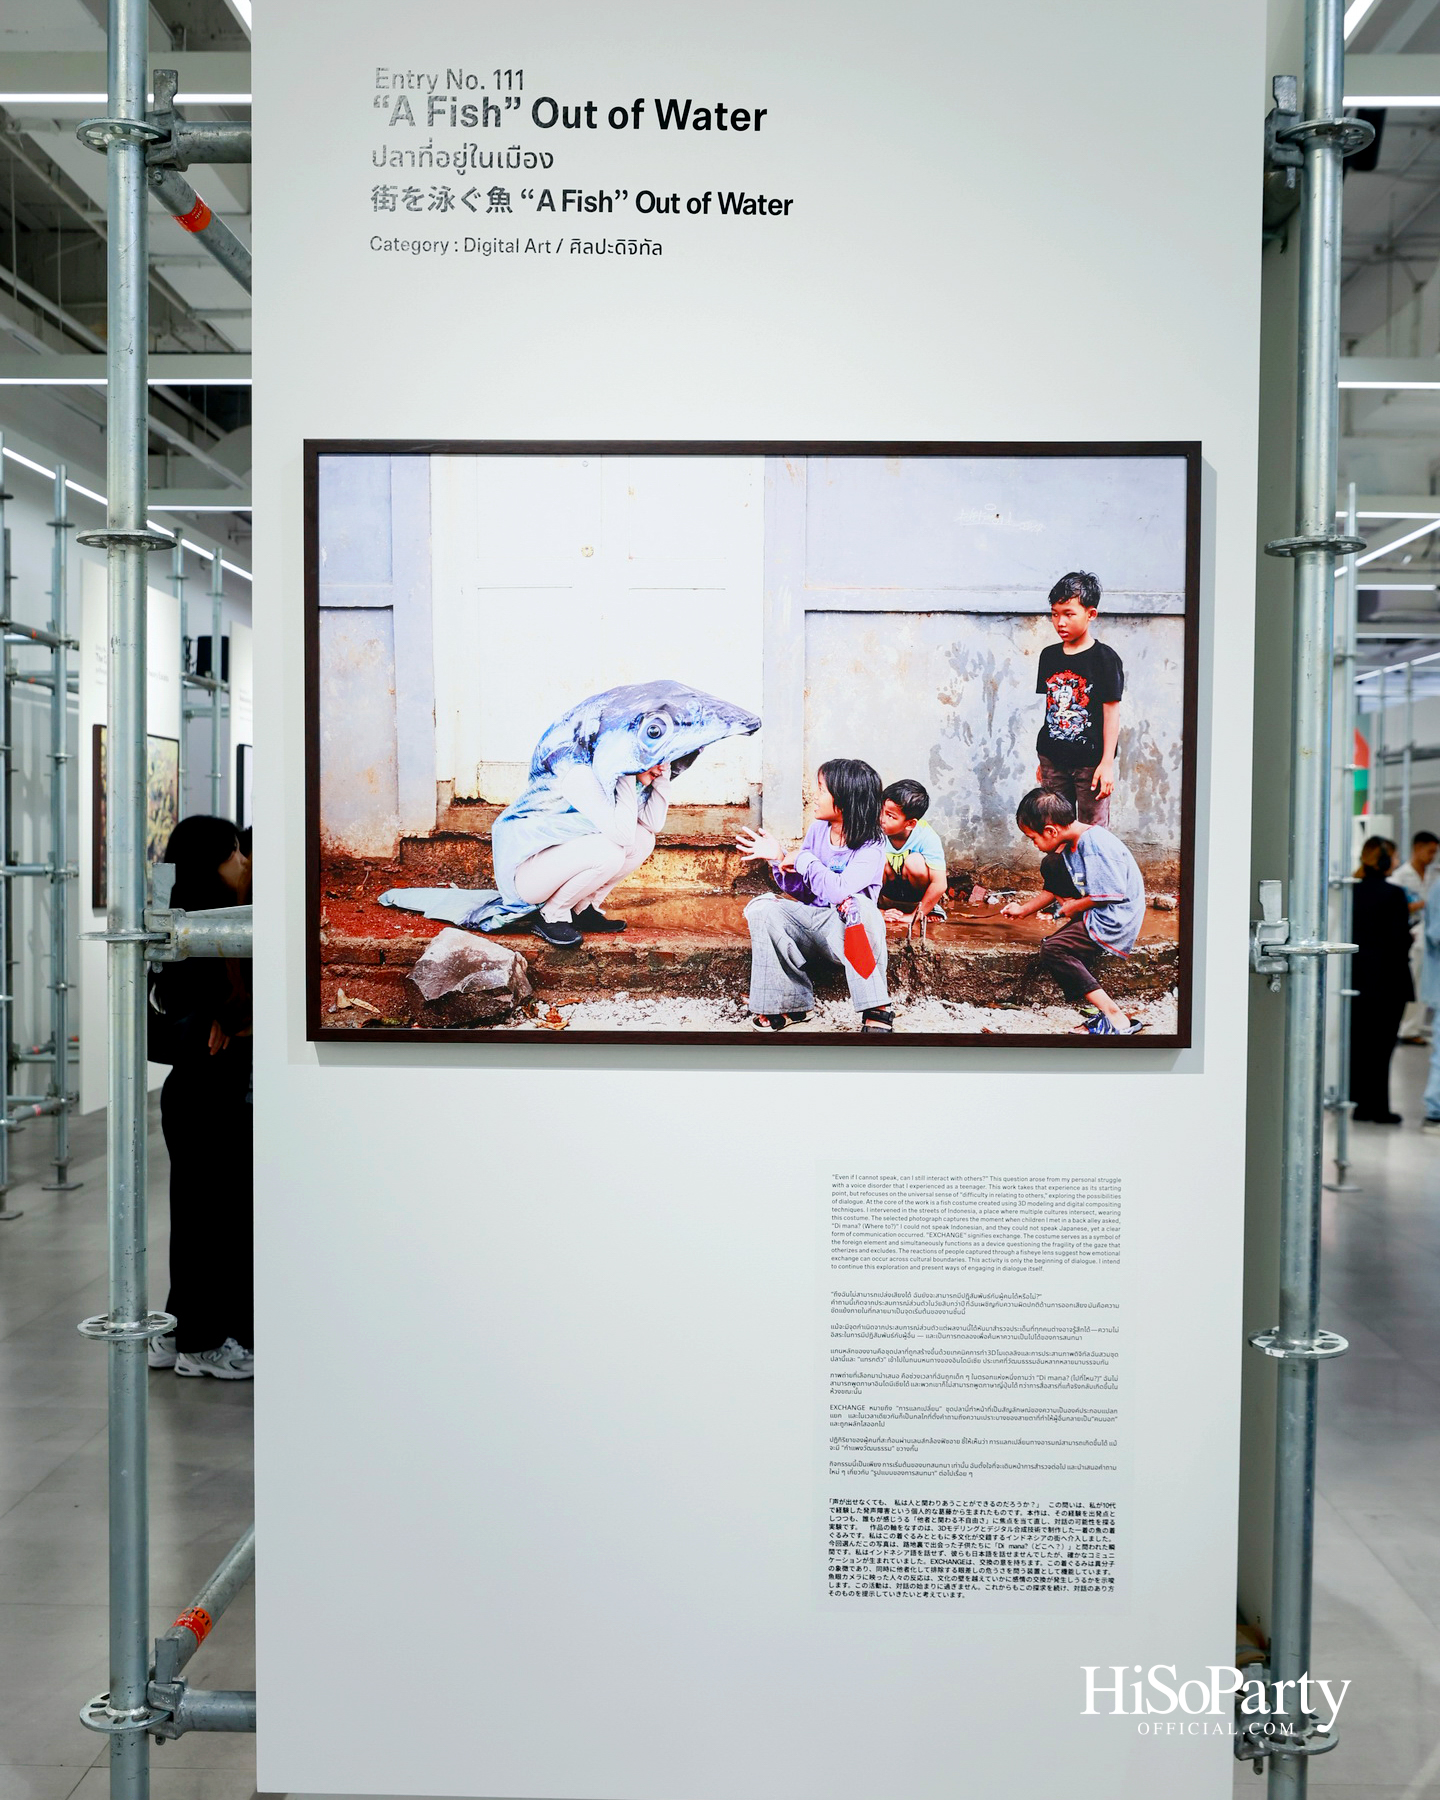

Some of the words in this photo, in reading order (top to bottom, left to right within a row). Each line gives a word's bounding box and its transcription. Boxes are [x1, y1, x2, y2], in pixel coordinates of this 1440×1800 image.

[375, 67, 438, 94] Entry
[446, 68, 485, 90] No.
[493, 69, 524, 90] 111
[531, 96, 598, 129] Out
[608, 98, 645, 130] of
[654, 98, 767, 131] Water
[372, 137, 554, 176] ปลาที่อยู่ในเมือง
[370, 184, 513, 213] 街を泳ぐ魚
[635, 190, 680, 214] Out
[686, 191, 712, 215] of
[717, 191, 794, 216] Water
[370, 236, 449, 255] Category
[464, 237, 519, 256] Digital
[524, 238, 551, 254] Art
[570, 238, 662, 256] ศิลปะดิจิทัล
